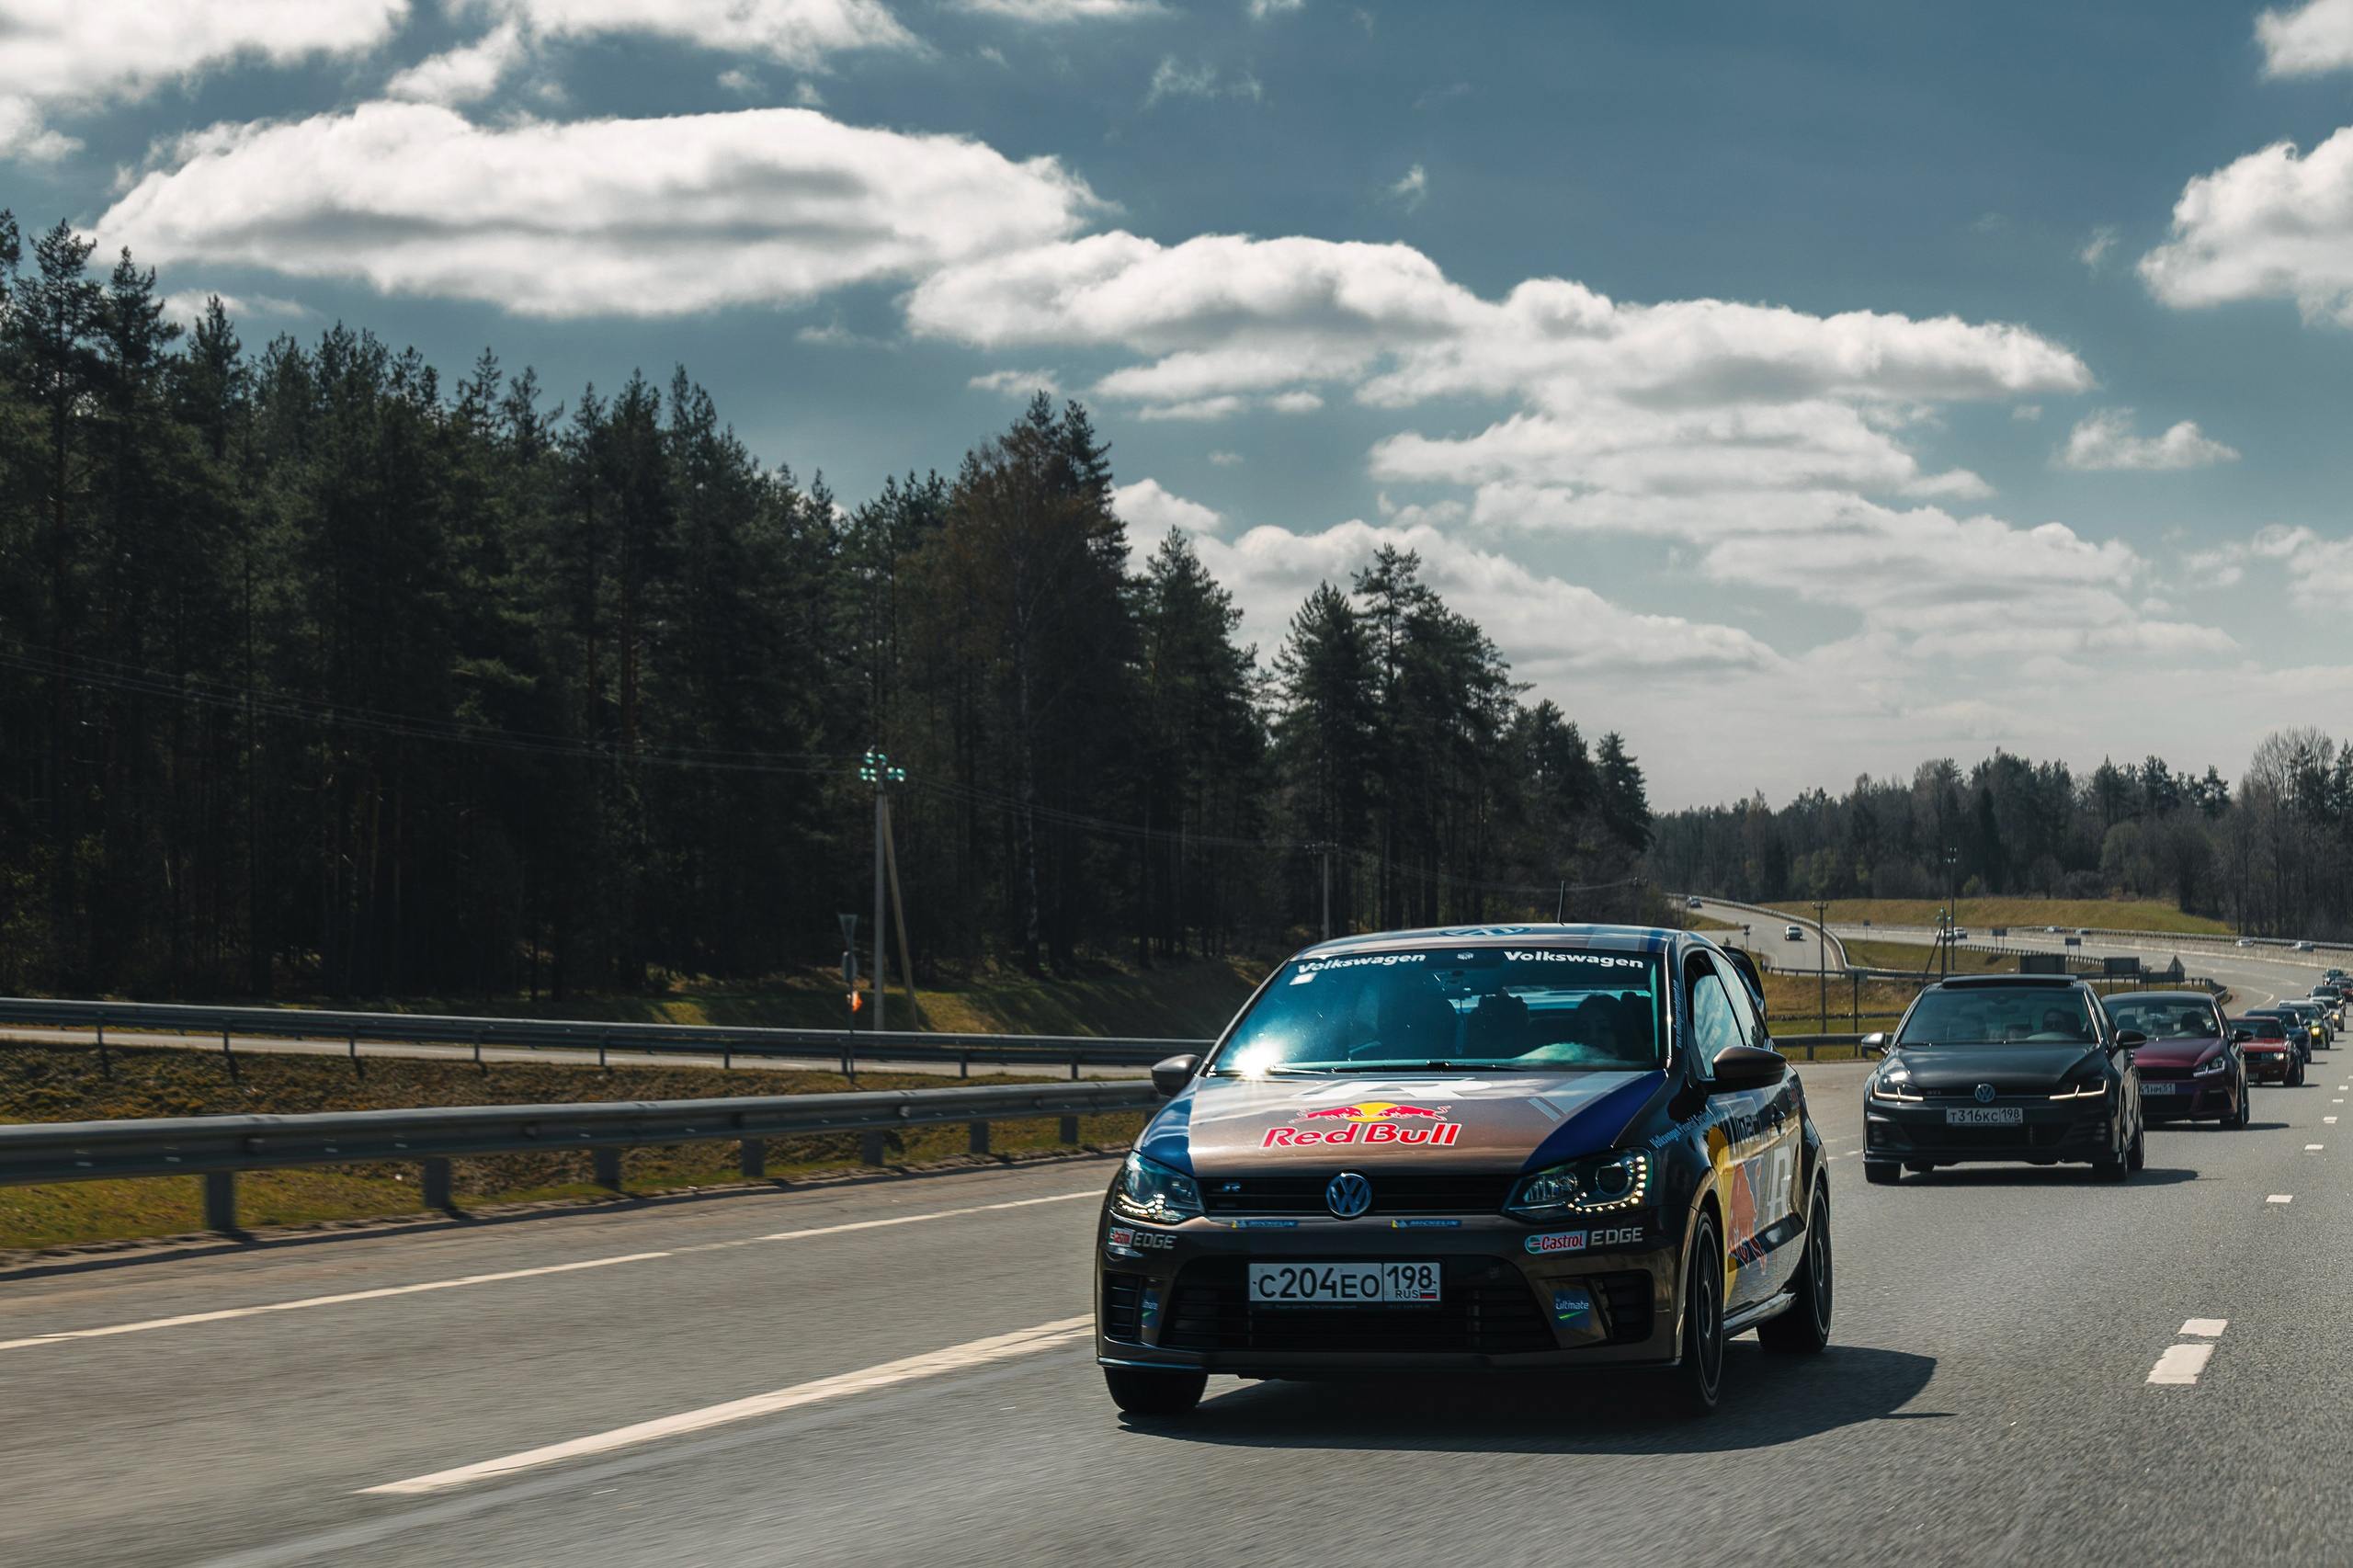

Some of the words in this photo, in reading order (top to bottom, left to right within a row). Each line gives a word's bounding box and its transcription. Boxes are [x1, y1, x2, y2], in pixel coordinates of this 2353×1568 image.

[1297, 951, 1427, 973] Volkswagen
[1504, 950, 1643, 969] Volkswagen
[2001, 1108, 2019, 1119] 198
[1259, 1122, 1363, 1149] Red
[1360, 1123, 1462, 1146] Bull
[1132, 1233, 1177, 1250] EDGE
[1541, 1233, 1584, 1251] Castrol
[1590, 1227, 1643, 1245] EDGE
[1386, 1265, 1432, 1290] 198
[1395, 1290, 1419, 1299] RUS
[1555, 1300, 1589, 1310] ultimate
